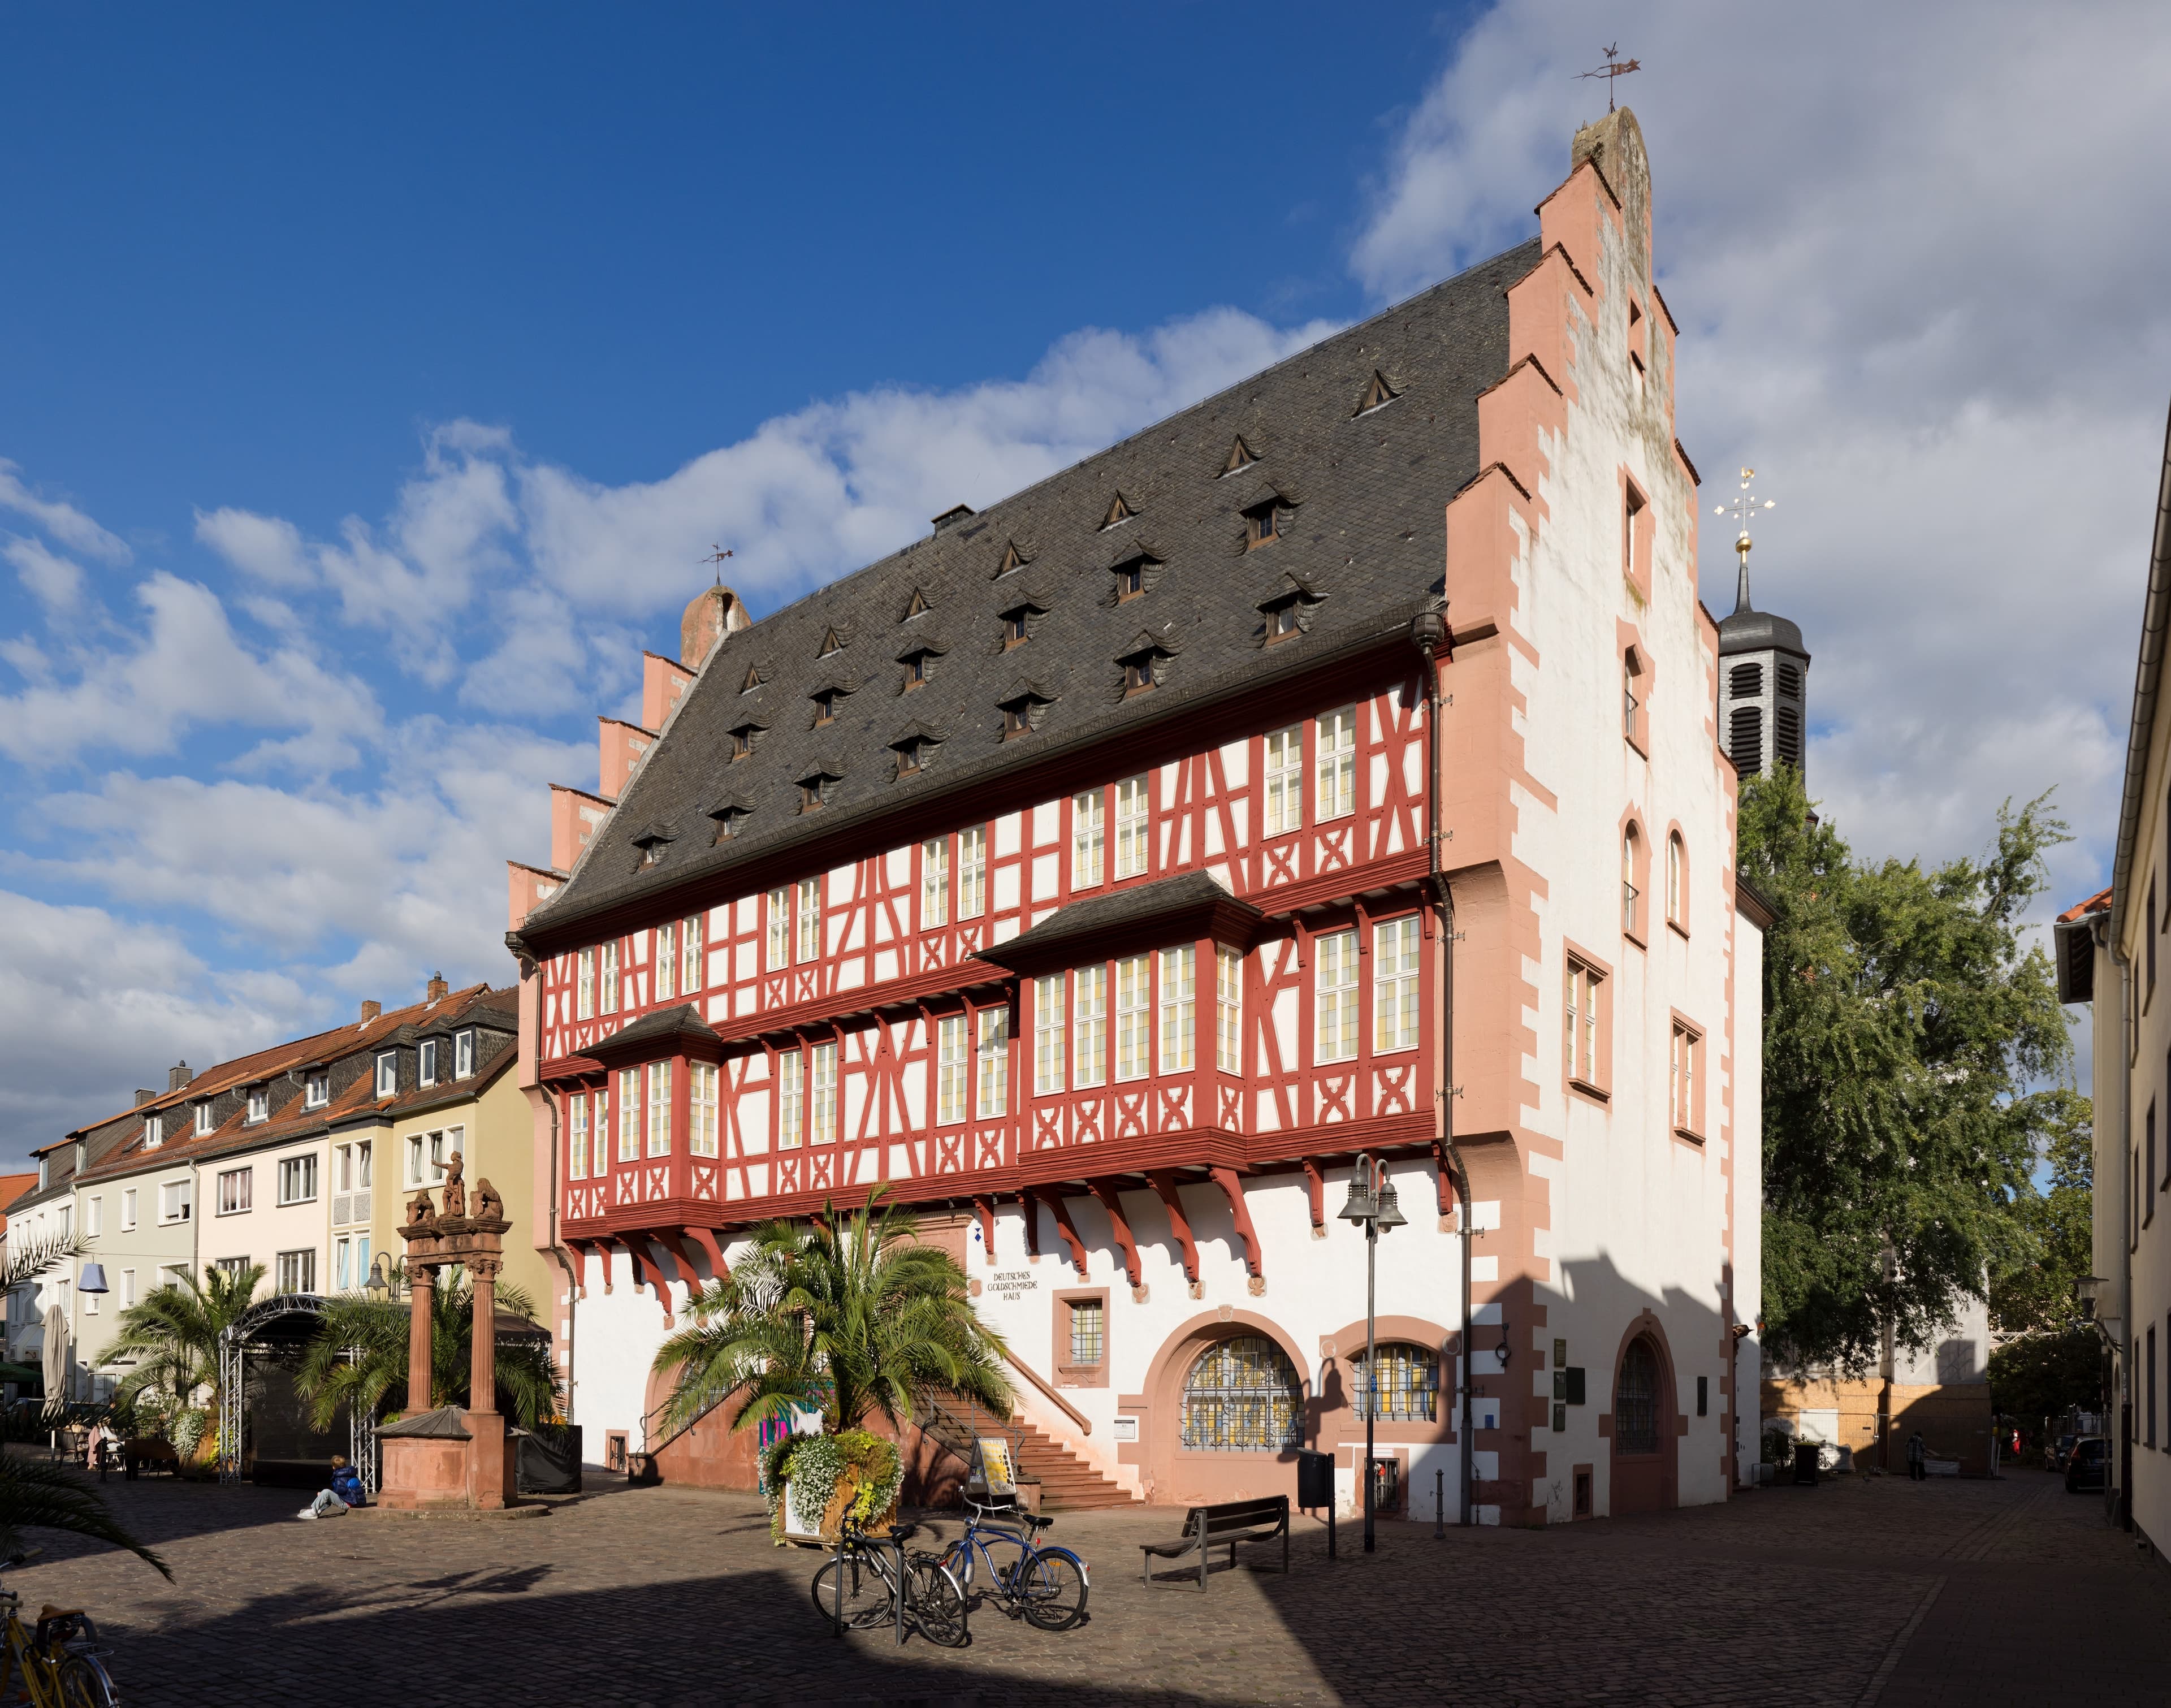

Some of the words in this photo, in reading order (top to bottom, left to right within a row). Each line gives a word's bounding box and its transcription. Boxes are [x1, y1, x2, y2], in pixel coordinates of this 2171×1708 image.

[994, 1271, 1030, 1281] DEUTSCHES
[987, 1281, 1037, 1291] GOLDSCHMIEDE
[1004, 1291, 1020, 1301] HAUS
